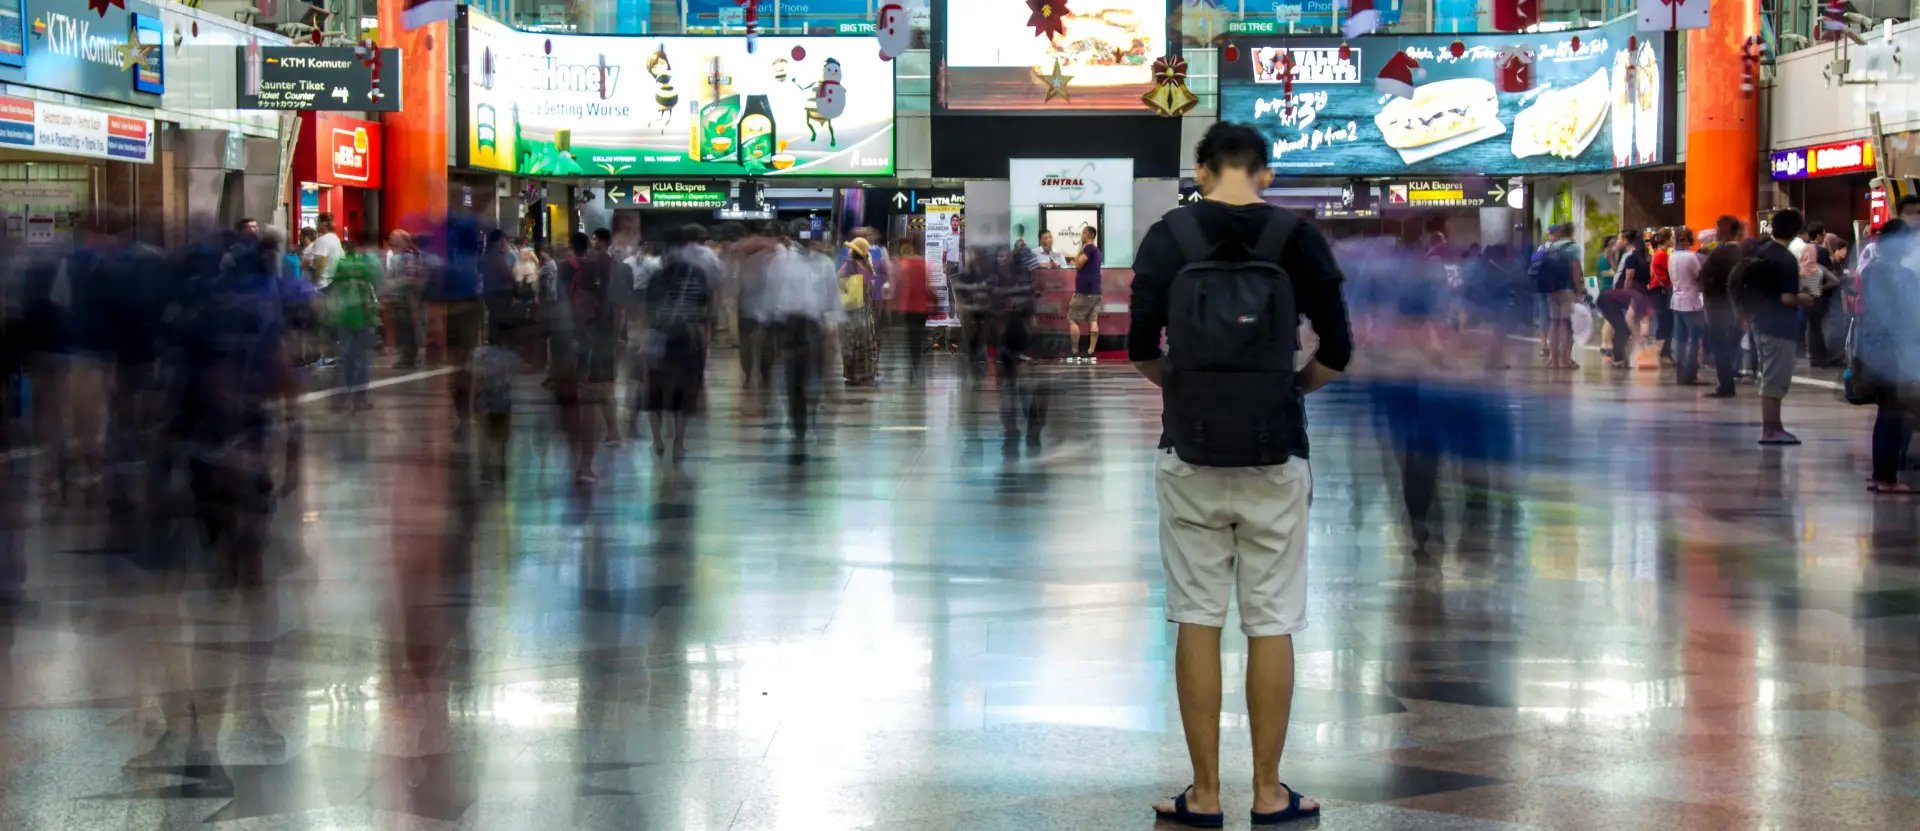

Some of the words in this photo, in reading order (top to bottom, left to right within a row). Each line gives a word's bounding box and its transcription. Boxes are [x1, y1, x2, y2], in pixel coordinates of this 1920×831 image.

[839, 23, 857, 32] BIG
[1229, 22, 1247, 31] BIG
[1248, 22, 1273, 31] TREE
[47, 11, 78, 59] KTM
[80, 20, 126, 67] Komute
[280, 57, 306, 69] KTM
[307, 57, 352, 69] Komuter
[258, 80, 297, 91] Kaunter
[299, 79, 325, 91] Tiket
[257, 91, 280, 100] Ticket
[284, 91, 316, 101] Counter
[586, 102, 630, 117] Worse
[652, 182, 674, 192] KLIA
[675, 182, 707, 194] Ekspres
[1040, 178, 1085, 187] SENTRAL
[1409, 181, 1430, 190] KLIA
[1431, 181, 1463, 192] Ekspres
[931, 197, 951, 206] KTM
